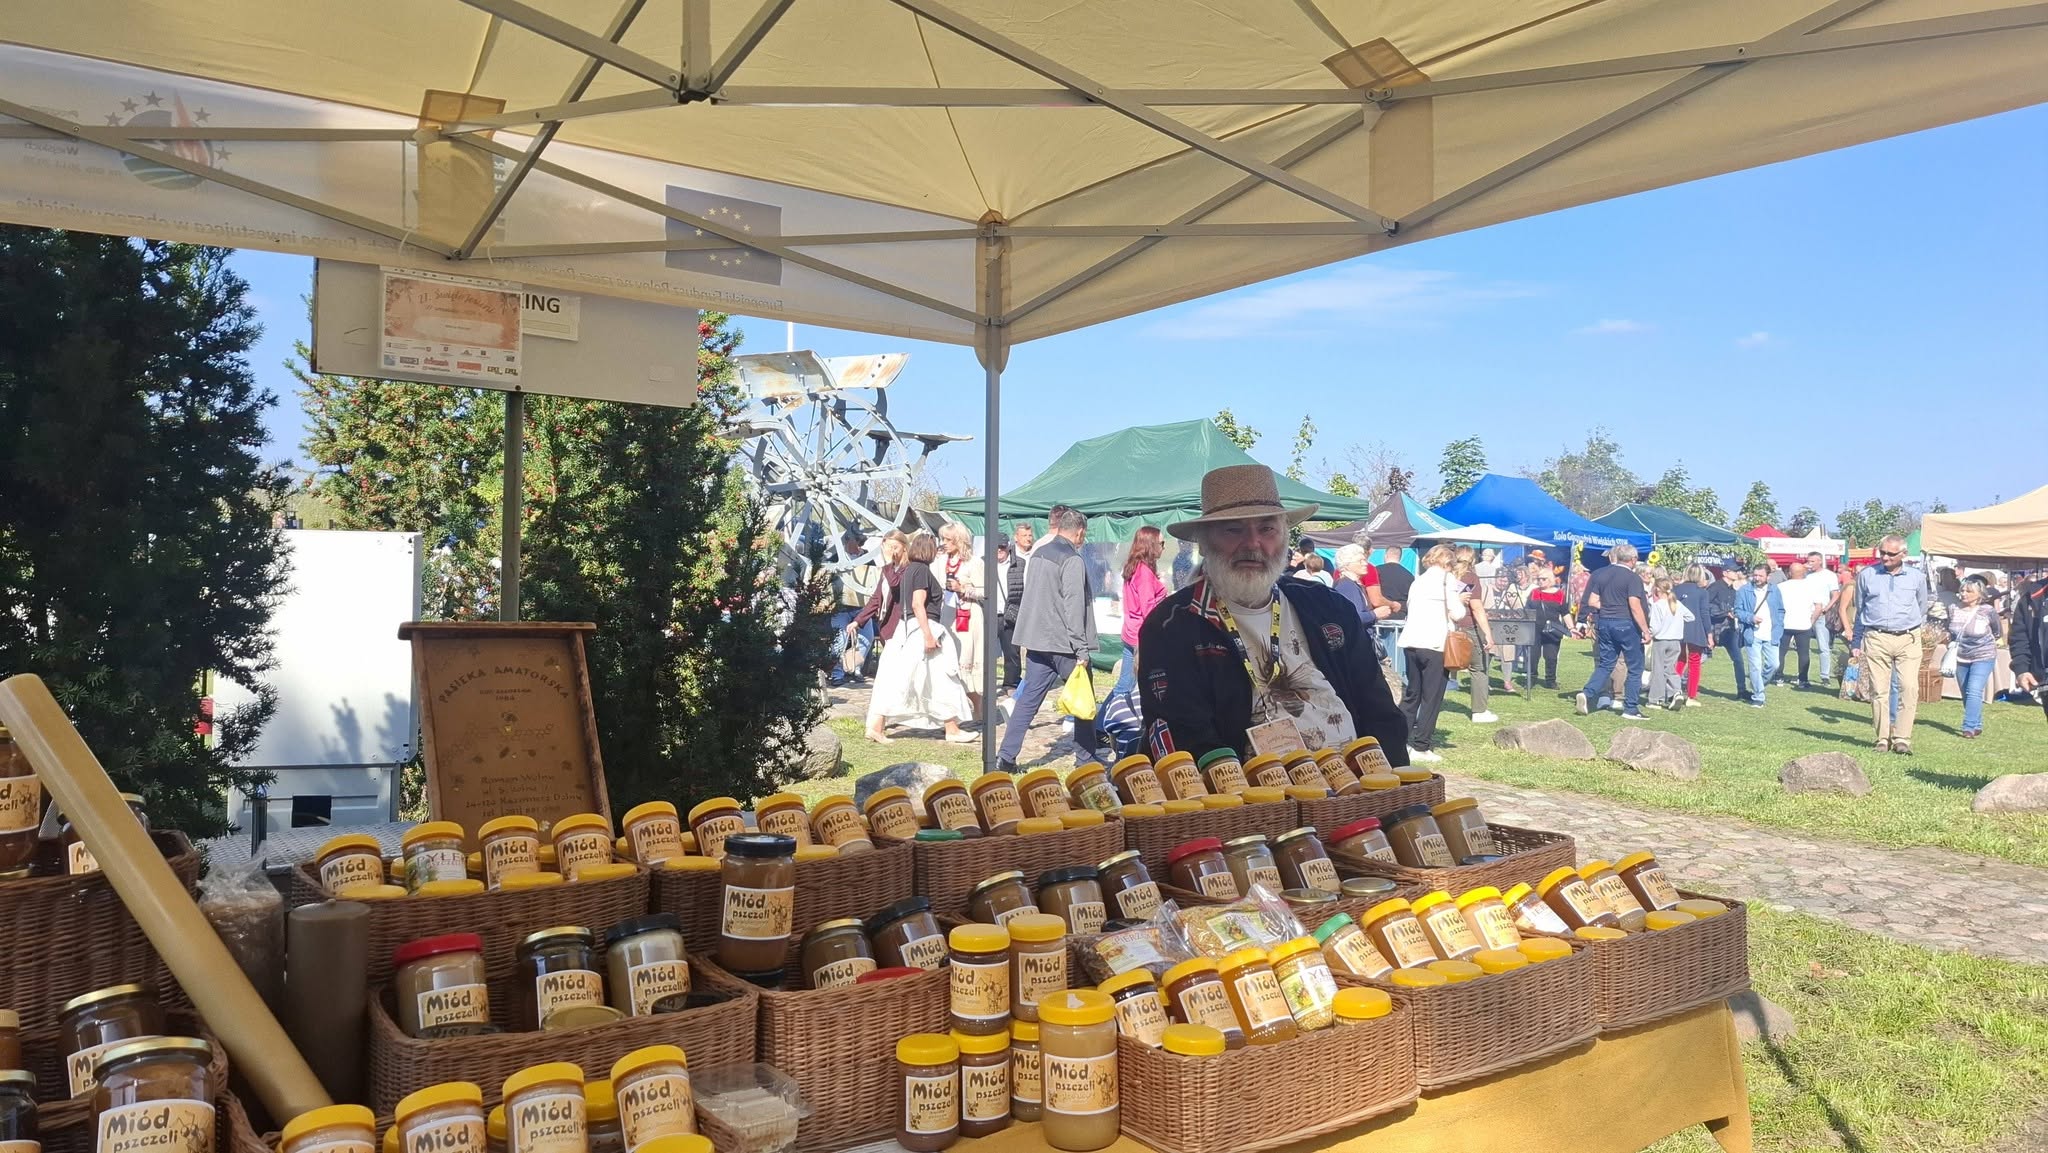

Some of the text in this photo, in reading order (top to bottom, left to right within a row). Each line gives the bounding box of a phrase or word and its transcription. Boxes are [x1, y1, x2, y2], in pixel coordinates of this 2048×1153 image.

[522, 293, 561, 313] ING
[438, 666, 569, 703] PASIEKA AMATORSKA
[1214, 765, 1239, 779] Miód
[940, 797, 967, 812] Miód
[985, 791, 1012, 807] Miód
[1034, 788, 1061, 802] Miód
[765, 814, 796, 832] Miód
[822, 812, 851, 833] Miód
[875, 807, 904, 828] Miód
[639, 823, 672, 840] Miód
[703, 821, 735, 840] Miód
[491, 841, 528, 860] Miód
[562, 838, 598, 858] Miód
[568, 850, 606, 865] pszczeli
[326, 859, 366, 881] Miód
[497, 854, 534, 867] pszczeli
[1308, 862, 1333, 876] Miód
[332, 872, 373, 889] pszczeli
[1207, 878, 1233, 890] Miód
[1254, 870, 1278, 882] Miód
[730, 891, 766, 908] Miód
[1123, 887, 1152, 907] Miód
[733, 909, 769, 918] pszczeli
[1077, 907, 1104, 920] Miód
[1114, 932, 1151, 945] PIERZ
[910, 940, 942, 961] Miód
[1024, 956, 1060, 973] Miód
[544, 974, 585, 994] Miód
[637, 966, 676, 987] Miód
[820, 963, 854, 987] Miód
[645, 982, 682, 997] pszczeli
[1244, 974, 1276, 996] Miód
[427, 990, 471, 1014] Miód
[551, 990, 592, 1005] pszczeli
[1188, 986, 1224, 1009] Miód
[435, 1006, 478, 1025] pszczeli
[1122, 997, 1158, 1022] Miód
[1013, 1052, 1040, 1070] Mió
[970, 1068, 1005, 1088] Miód
[1018, 1072, 1039, 1080] pszc
[1050, 1062, 1089, 1080] Miód
[913, 1080, 951, 1099] Miód
[1056, 1080, 1095, 1091] pszczeli
[624, 1080, 671, 1112] Miód
[522, 1101, 572, 1127] Miód
[632, 1100, 680, 1123] pszczeli
[107, 1107, 170, 1139] Miód
[530, 1121, 579, 1142] pszczeli
[113, 1130, 178, 1153] pszczeli
[416, 1124, 469, 1153] Miód
